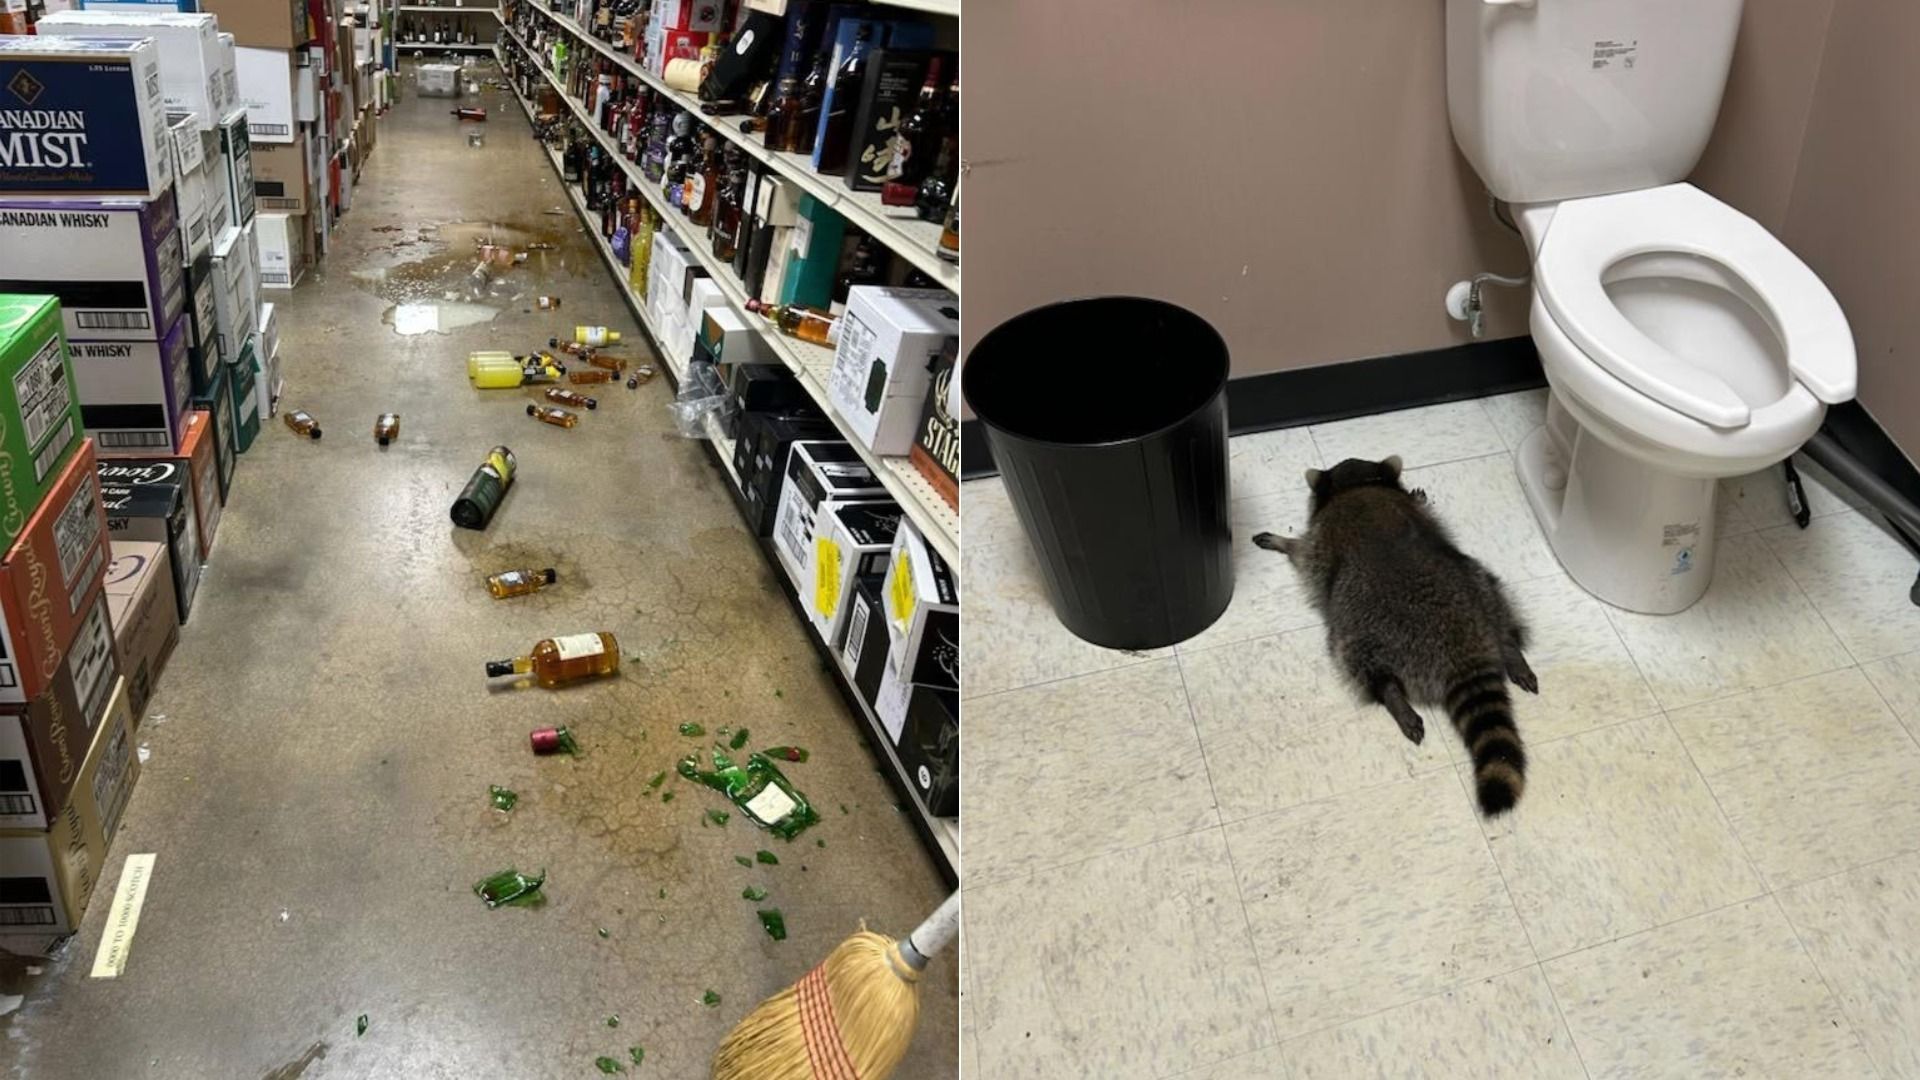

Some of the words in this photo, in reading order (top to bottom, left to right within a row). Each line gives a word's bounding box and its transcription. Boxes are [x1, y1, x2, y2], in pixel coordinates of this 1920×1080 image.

[0, 132, 87, 168] MIST
[59, 213, 110, 228] WHISKY
[86, 345, 132, 358] WHISKY
[924, 416, 958, 480] STAG
[114, 929, 125, 942] TO
